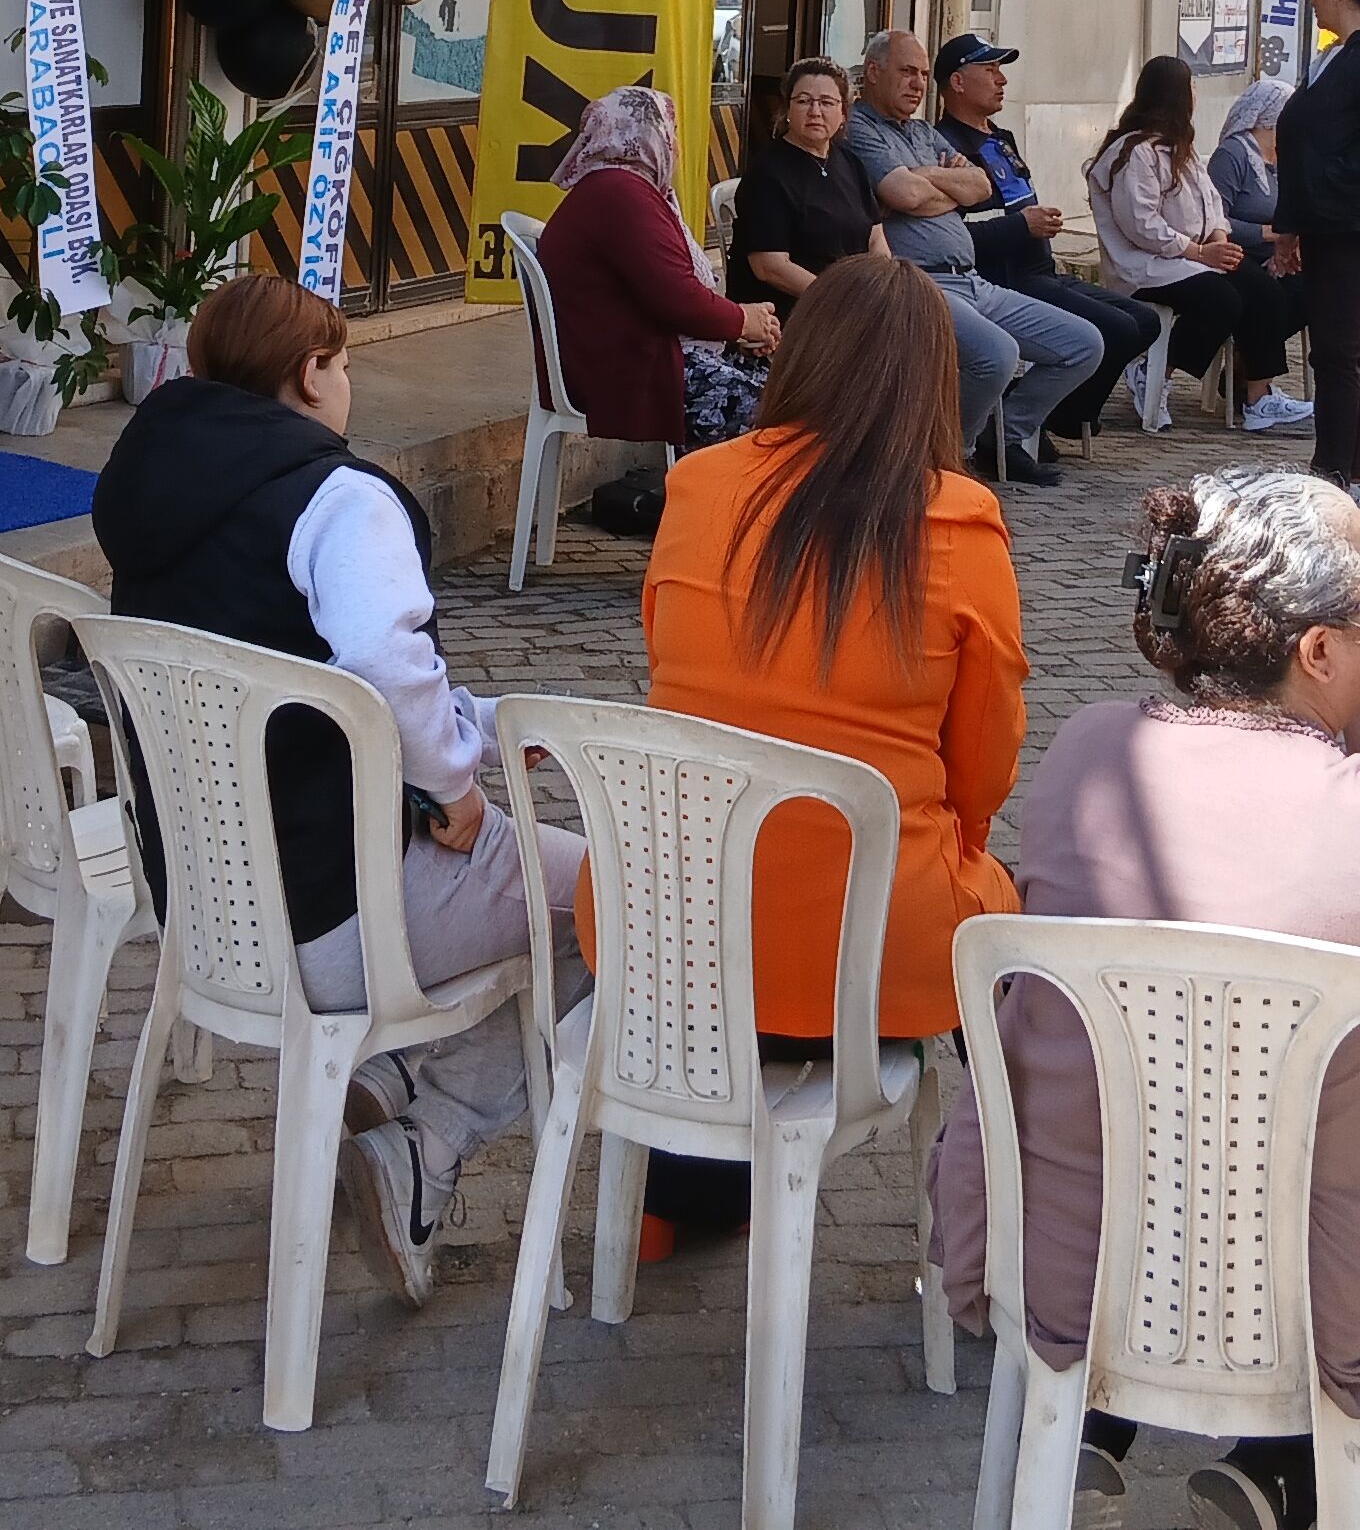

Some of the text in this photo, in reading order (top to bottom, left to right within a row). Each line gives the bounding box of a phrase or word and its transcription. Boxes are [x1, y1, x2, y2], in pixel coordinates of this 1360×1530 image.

[51, 23, 88, 171] SANATKARLAR
[318, 69, 340, 160] AKİF
[64, 172, 93, 233] ODASI
[322, 99, 353, 304] ÇİĞKÖFT
